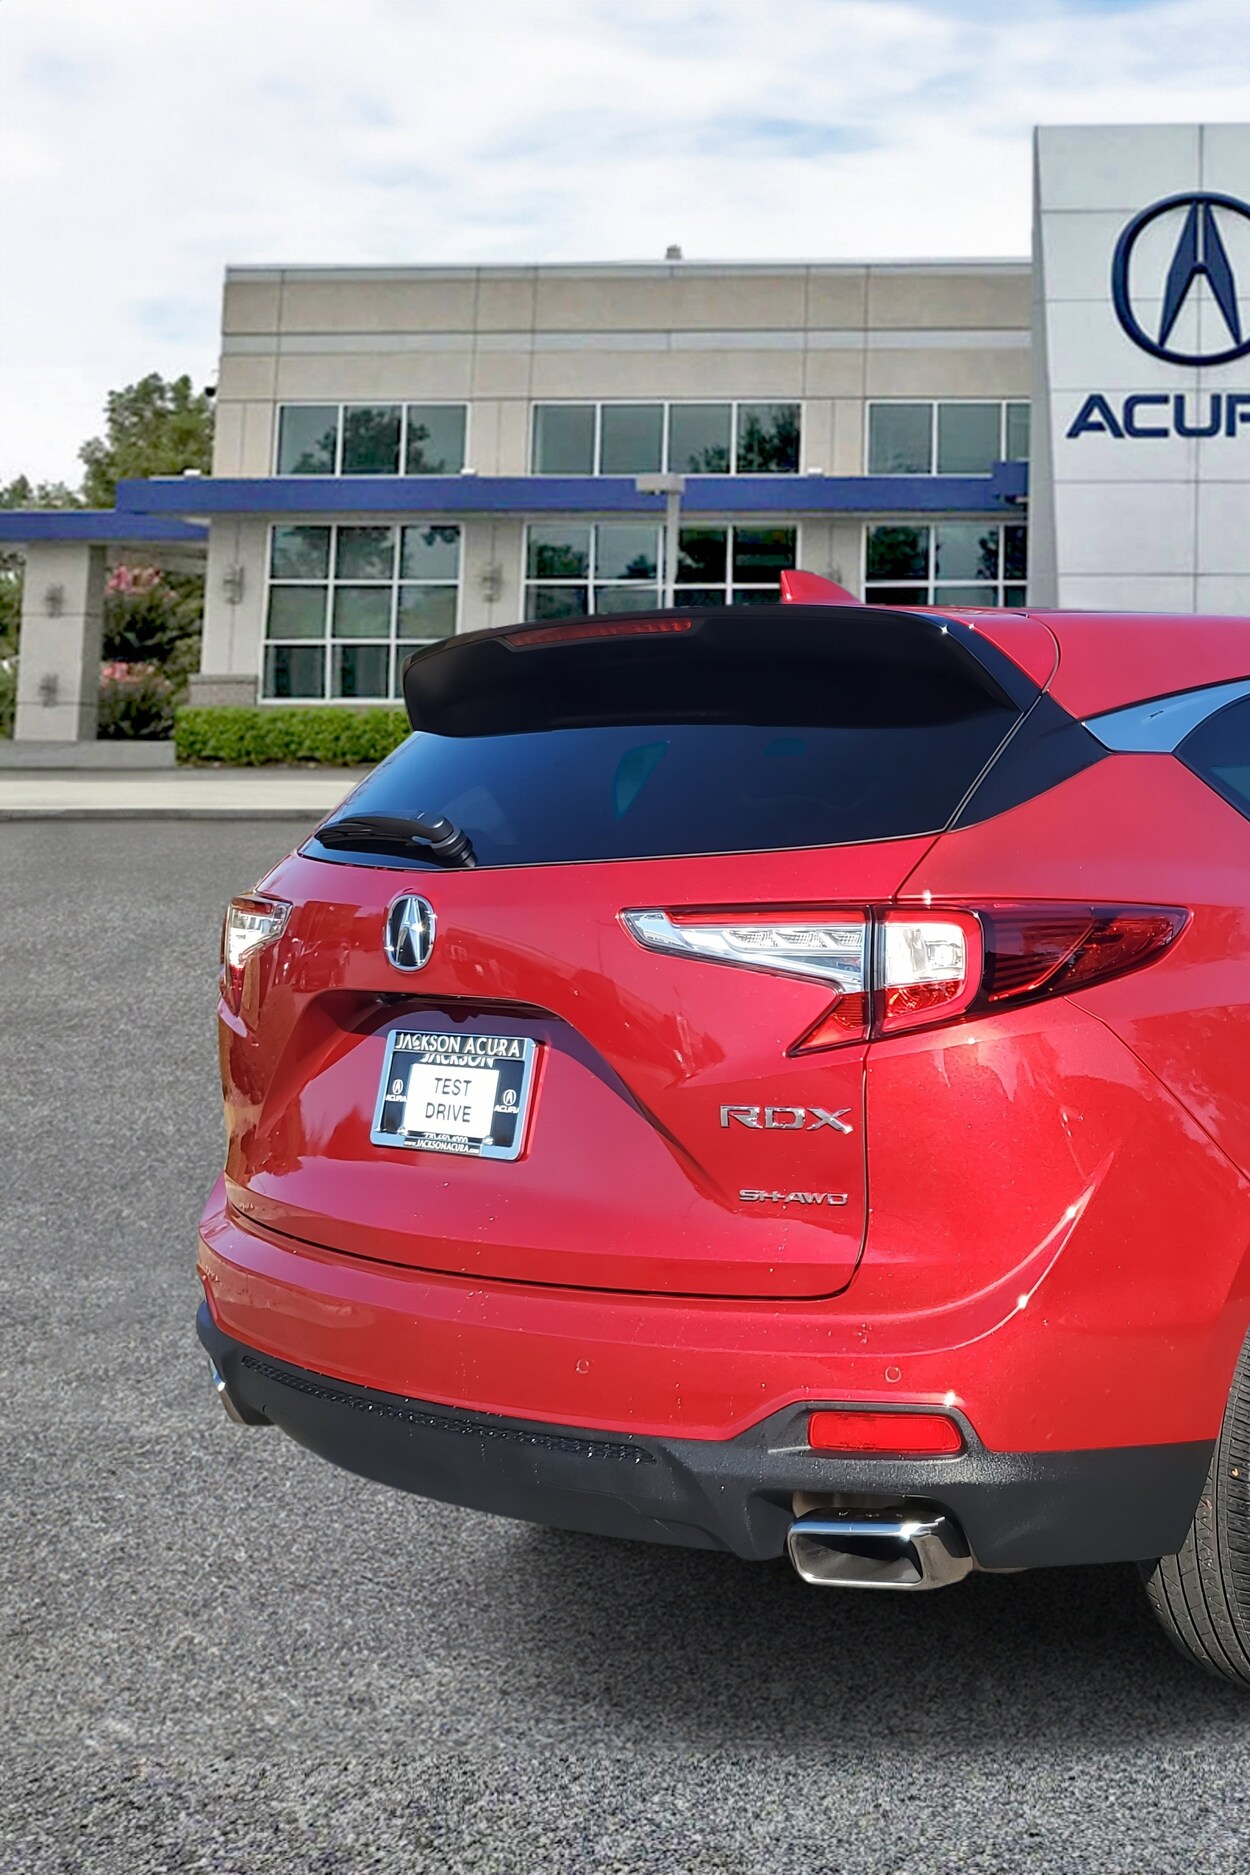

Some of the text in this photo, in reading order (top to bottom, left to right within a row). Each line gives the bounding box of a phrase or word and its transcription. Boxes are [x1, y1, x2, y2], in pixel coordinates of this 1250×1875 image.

[395, 1033, 521, 1058] JACKSON ACURA
[434, 1077, 472, 1097] TEST
[385, 1094, 407, 1103] ACURA
[424, 1102, 472, 1123] DRIVE
[720, 1105, 853, 1134] RDX
[738, 1189, 848, 1206] SH-AWD
